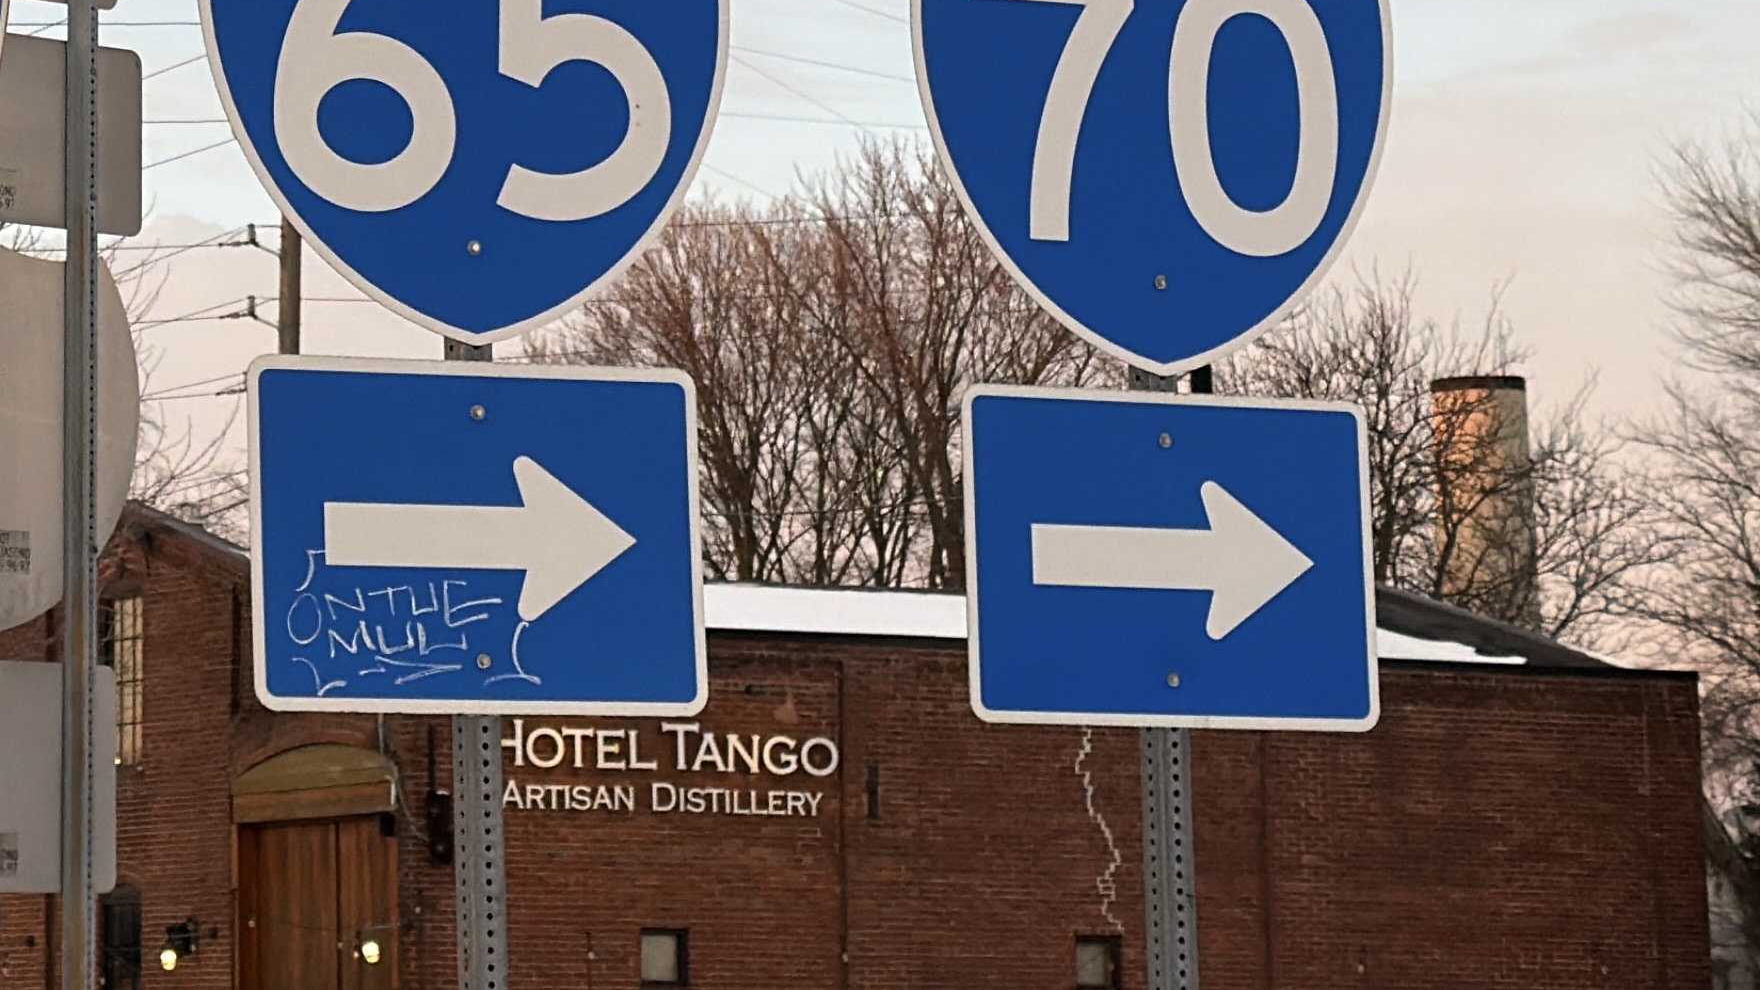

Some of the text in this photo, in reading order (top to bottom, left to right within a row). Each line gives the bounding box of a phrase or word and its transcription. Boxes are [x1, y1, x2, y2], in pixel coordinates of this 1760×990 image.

[501, 718, 840, 777] HOTEL TANGO
[502, 779, 824, 817] ARTISAN DISTILLERY
